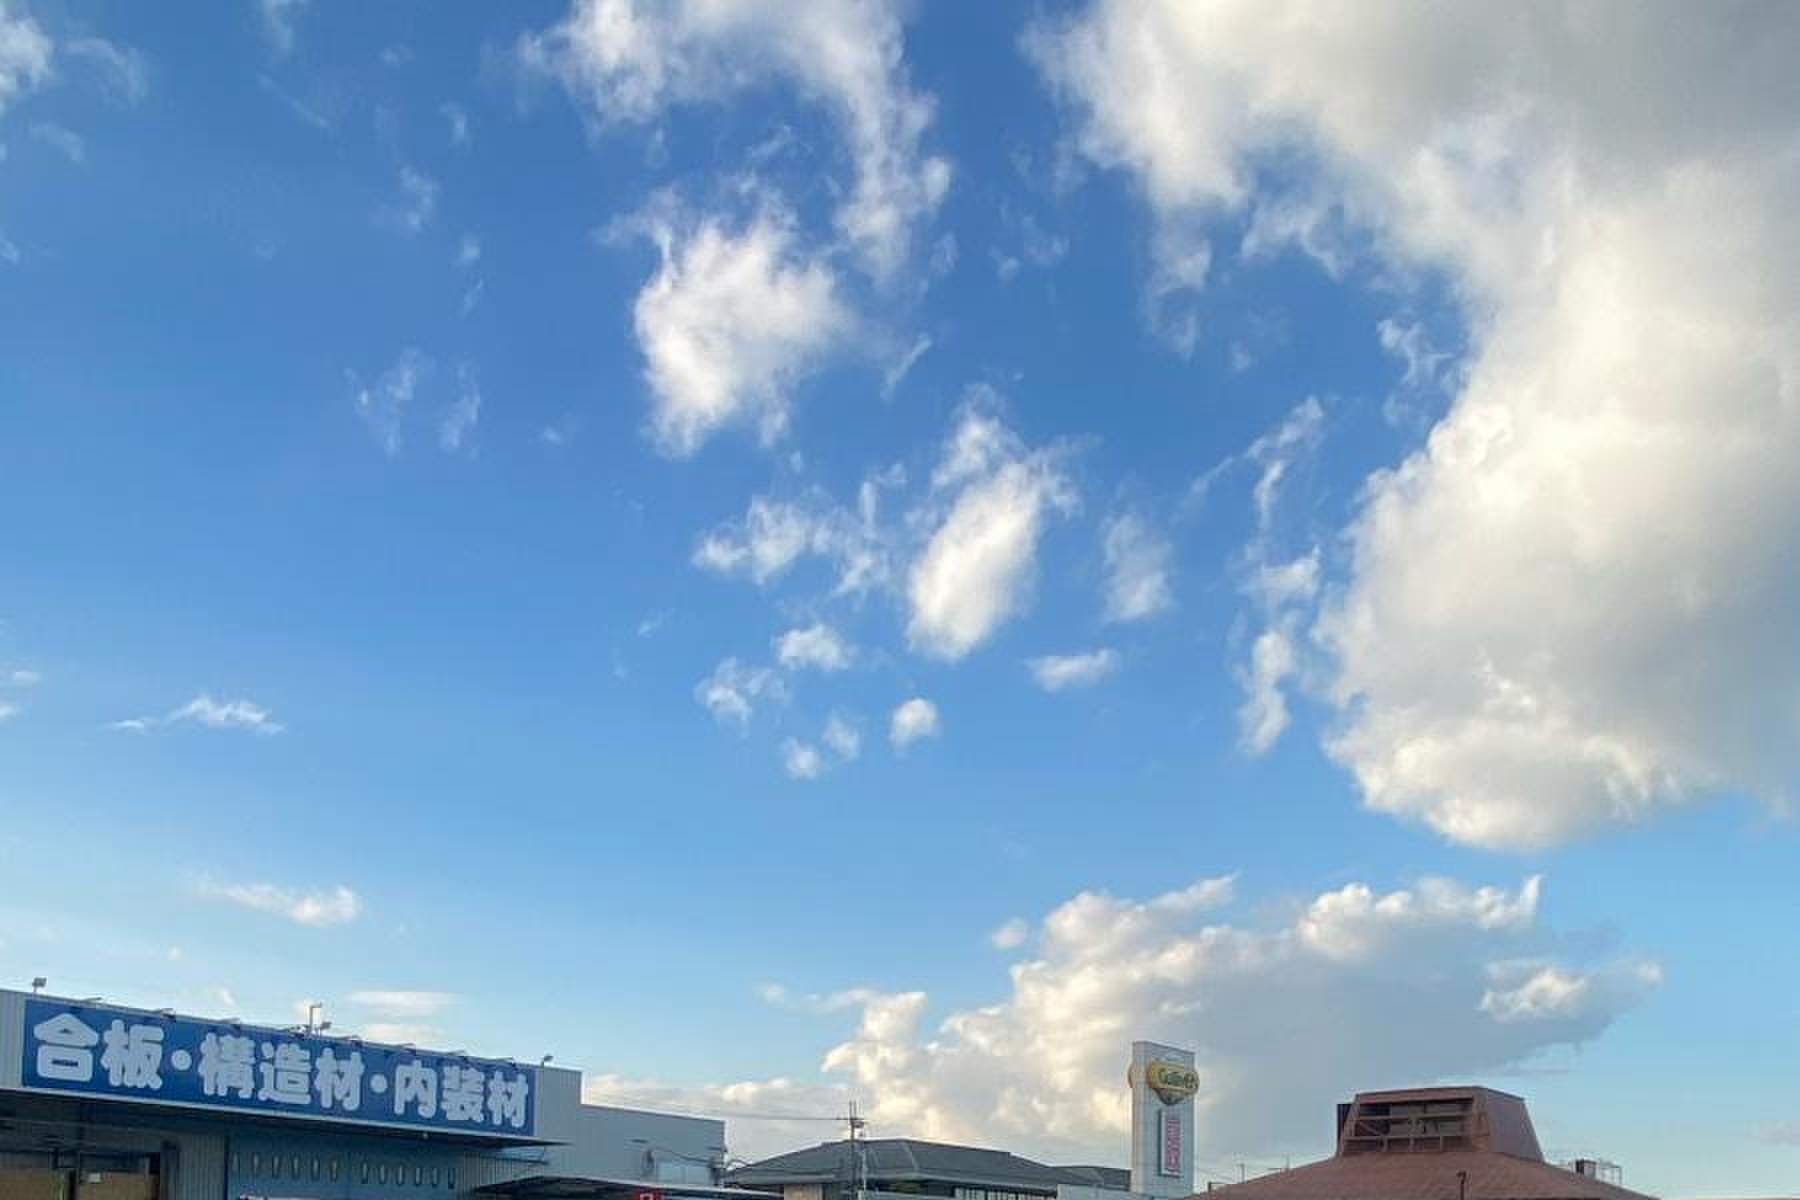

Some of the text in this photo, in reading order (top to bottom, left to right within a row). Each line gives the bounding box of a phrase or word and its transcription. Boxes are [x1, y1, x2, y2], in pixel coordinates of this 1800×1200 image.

[34, 1013, 528, 1128] 合板・構造材・内装材
